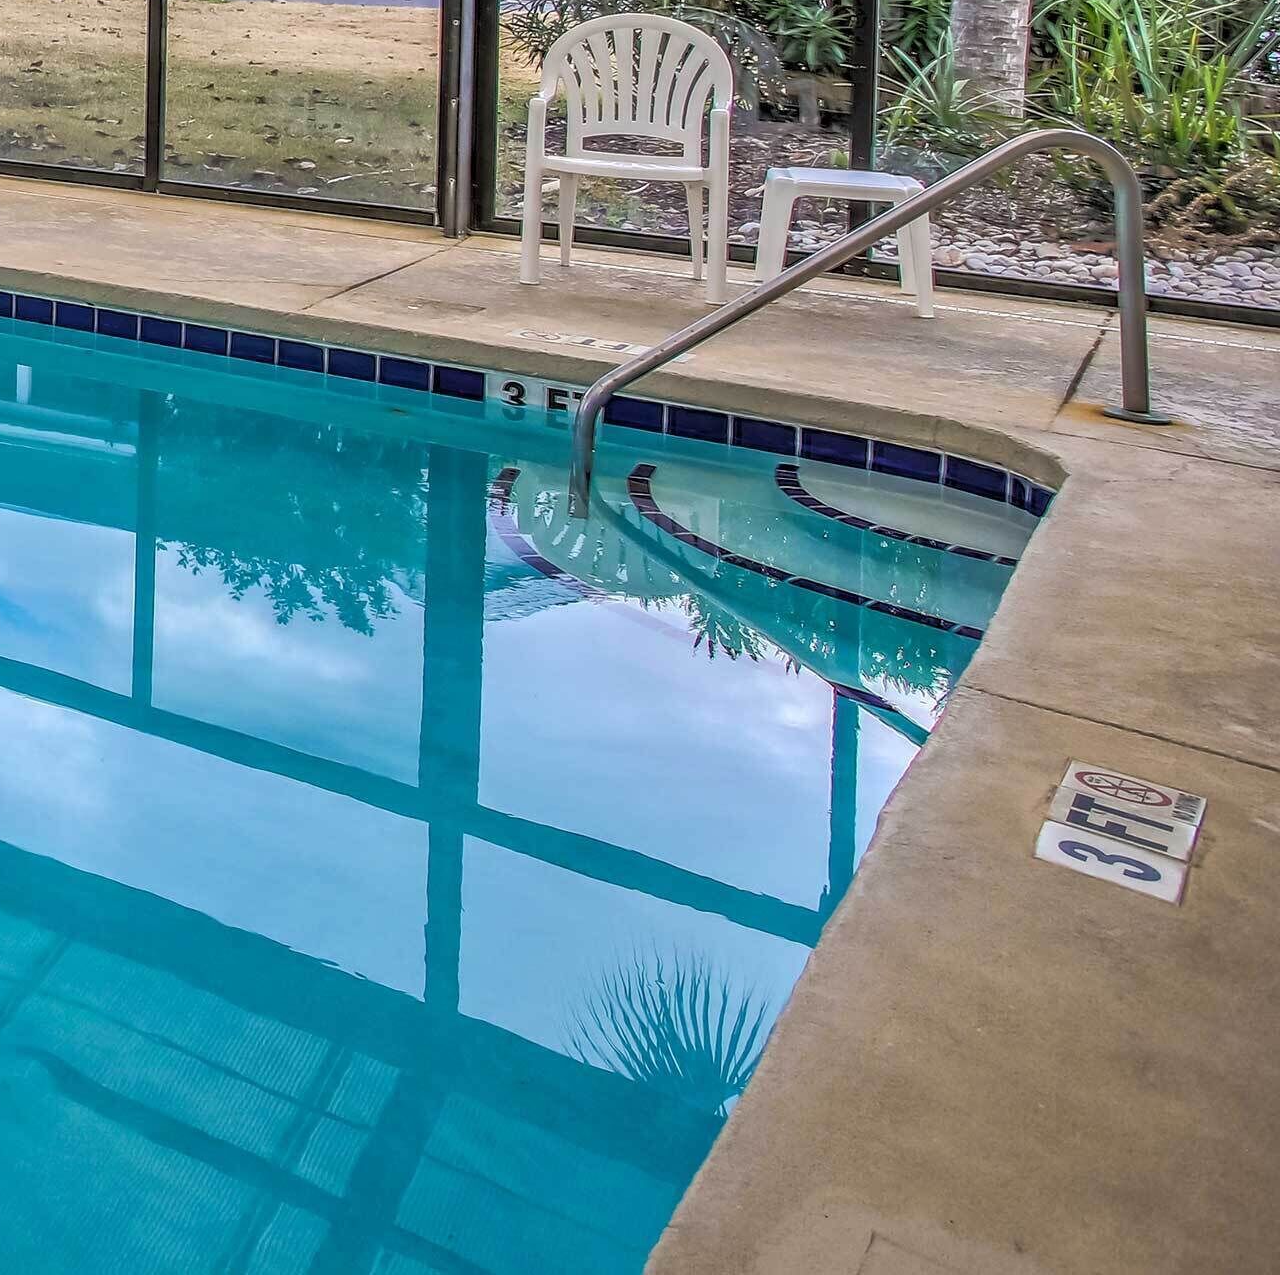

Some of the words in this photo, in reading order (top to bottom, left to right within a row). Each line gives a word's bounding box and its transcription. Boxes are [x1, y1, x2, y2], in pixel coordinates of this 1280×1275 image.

[501, 380, 527, 406] 3
[1065, 792, 1174, 853] FT
[1058, 840, 1162, 882] 3
